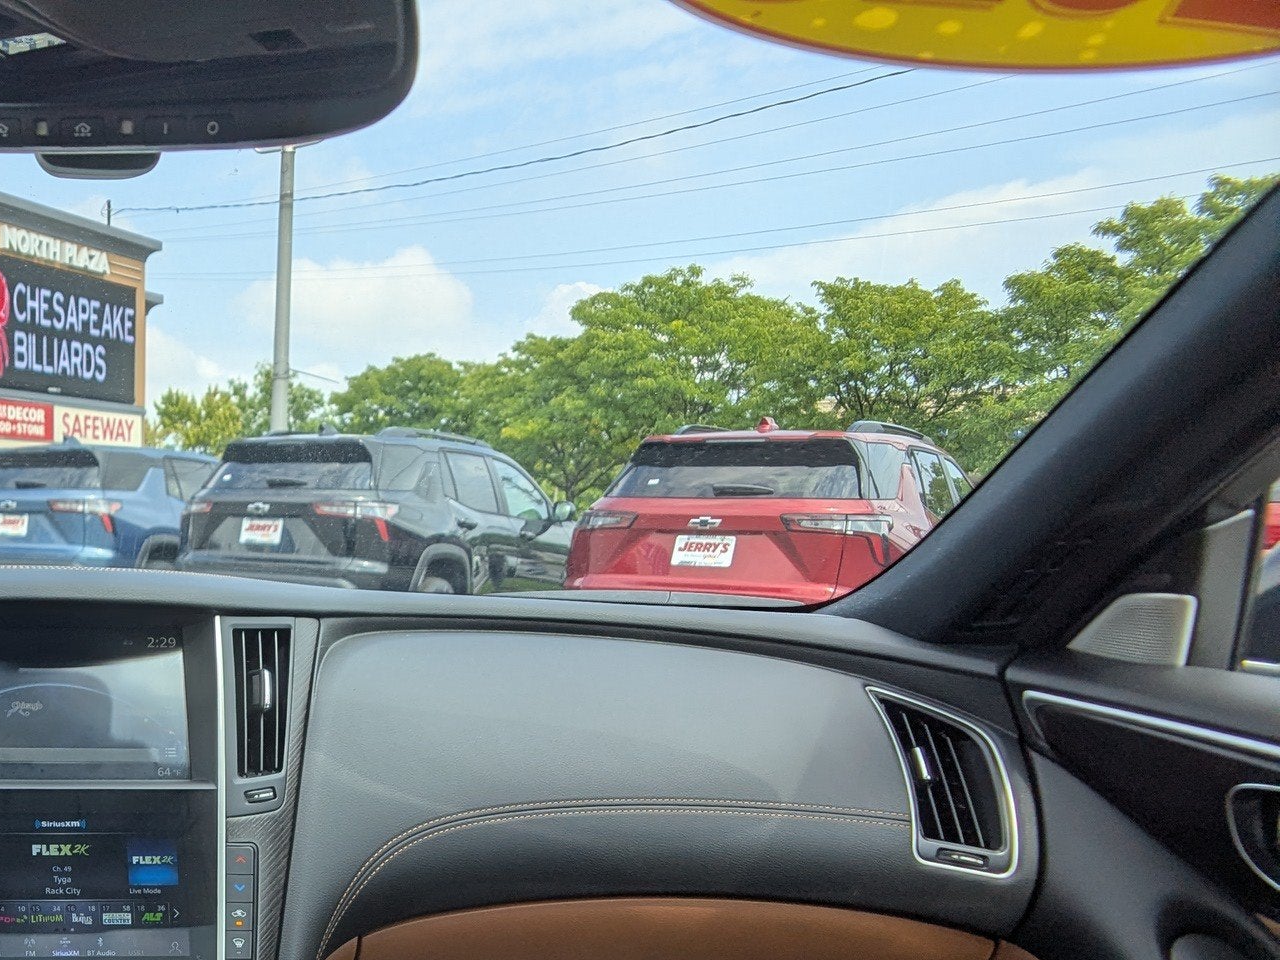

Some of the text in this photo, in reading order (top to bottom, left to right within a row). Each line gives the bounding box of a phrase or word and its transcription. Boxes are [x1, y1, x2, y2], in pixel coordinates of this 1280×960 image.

[0, 224, 111, 275] NORTH PLAZA
[12, 282, 135, 344] CHESAPEAKE
[13, 331, 107, 383] BILLIARDS
[7, 406, 46, 423] DECOR
[62, 412, 135, 443] SAFEWAY
[677, 541, 731, 554] JERRY'S
[147, 637, 177, 648] 2:29
[157, 766, 172, 776] 64
[31, 844, 72, 856] FLEX
[132, 856, 161, 865] FLEX
[53, 875, 72, 884] Tyga
[65, 887, 81, 896] City
